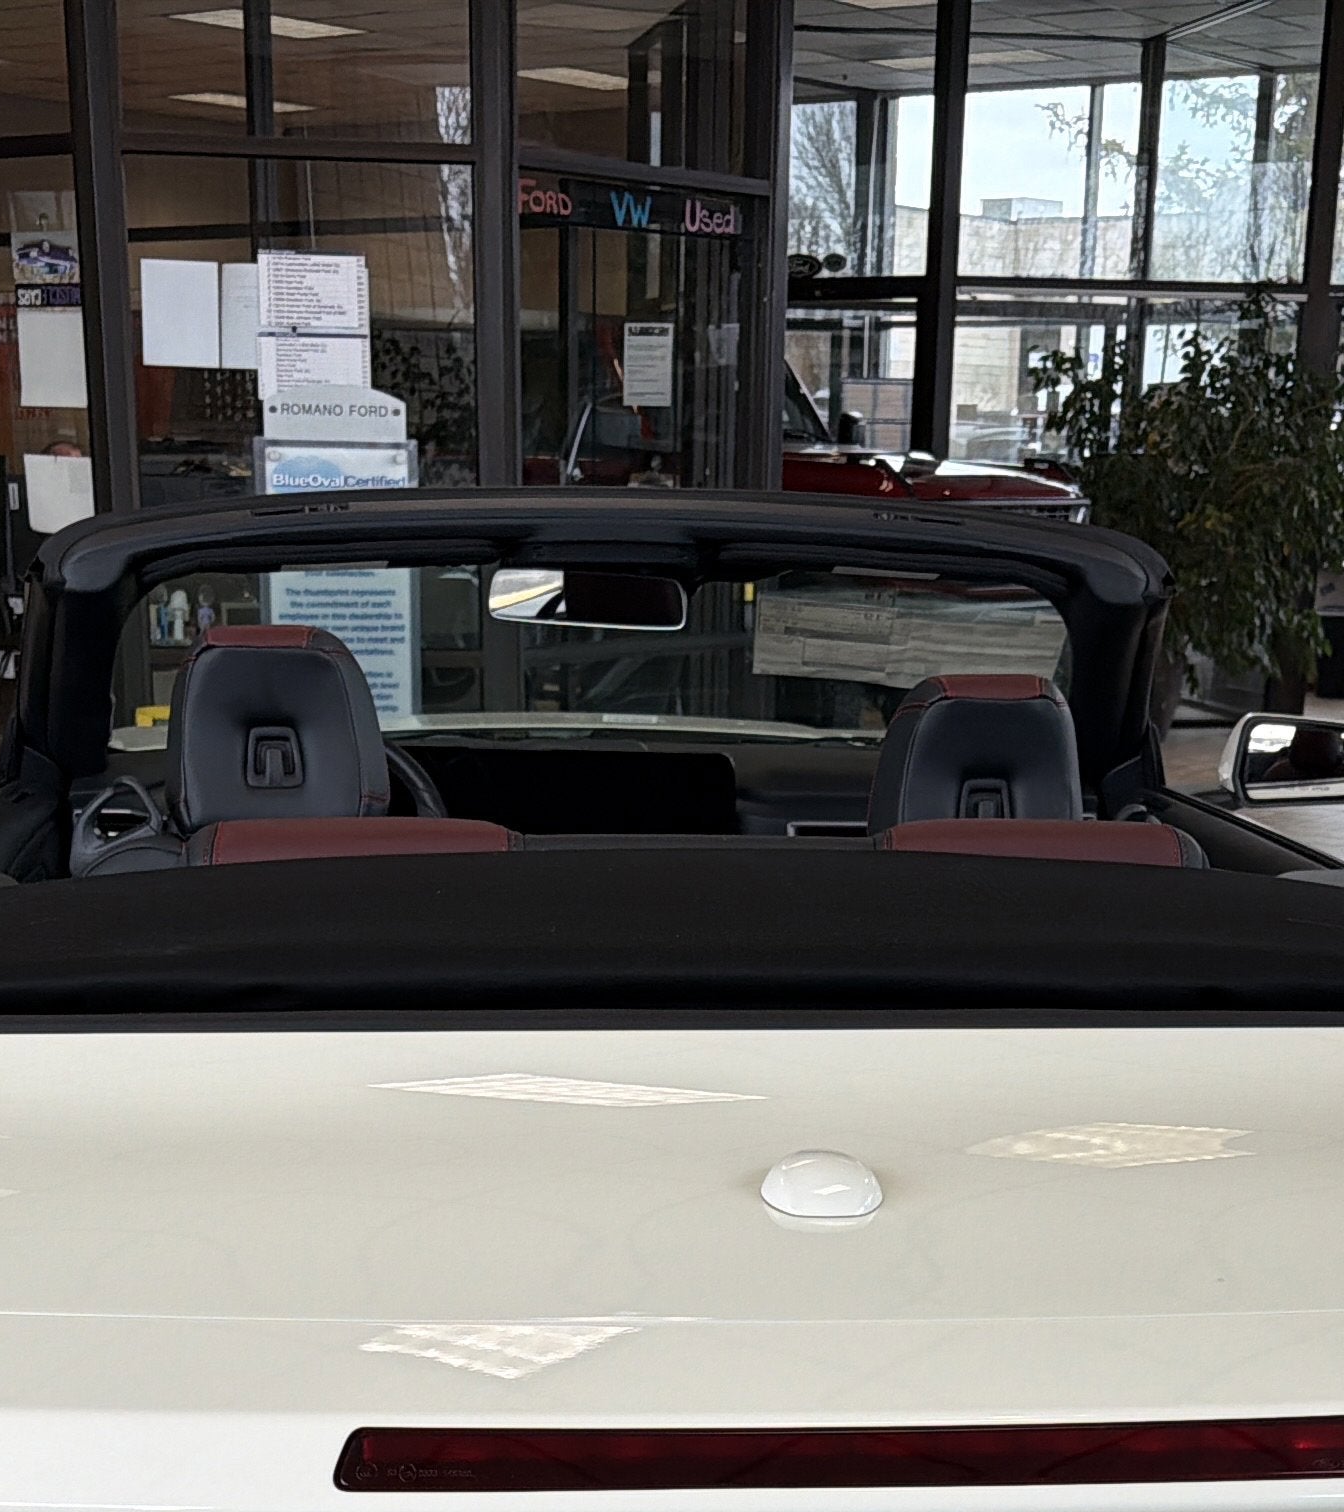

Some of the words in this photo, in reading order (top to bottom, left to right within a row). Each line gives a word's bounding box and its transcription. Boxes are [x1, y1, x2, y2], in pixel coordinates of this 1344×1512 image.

[610, 191, 652, 228] VW
[685, 199, 736, 234] Used
[280, 403, 343, 416] ROMANO
[349, 404, 388, 417] FORD
